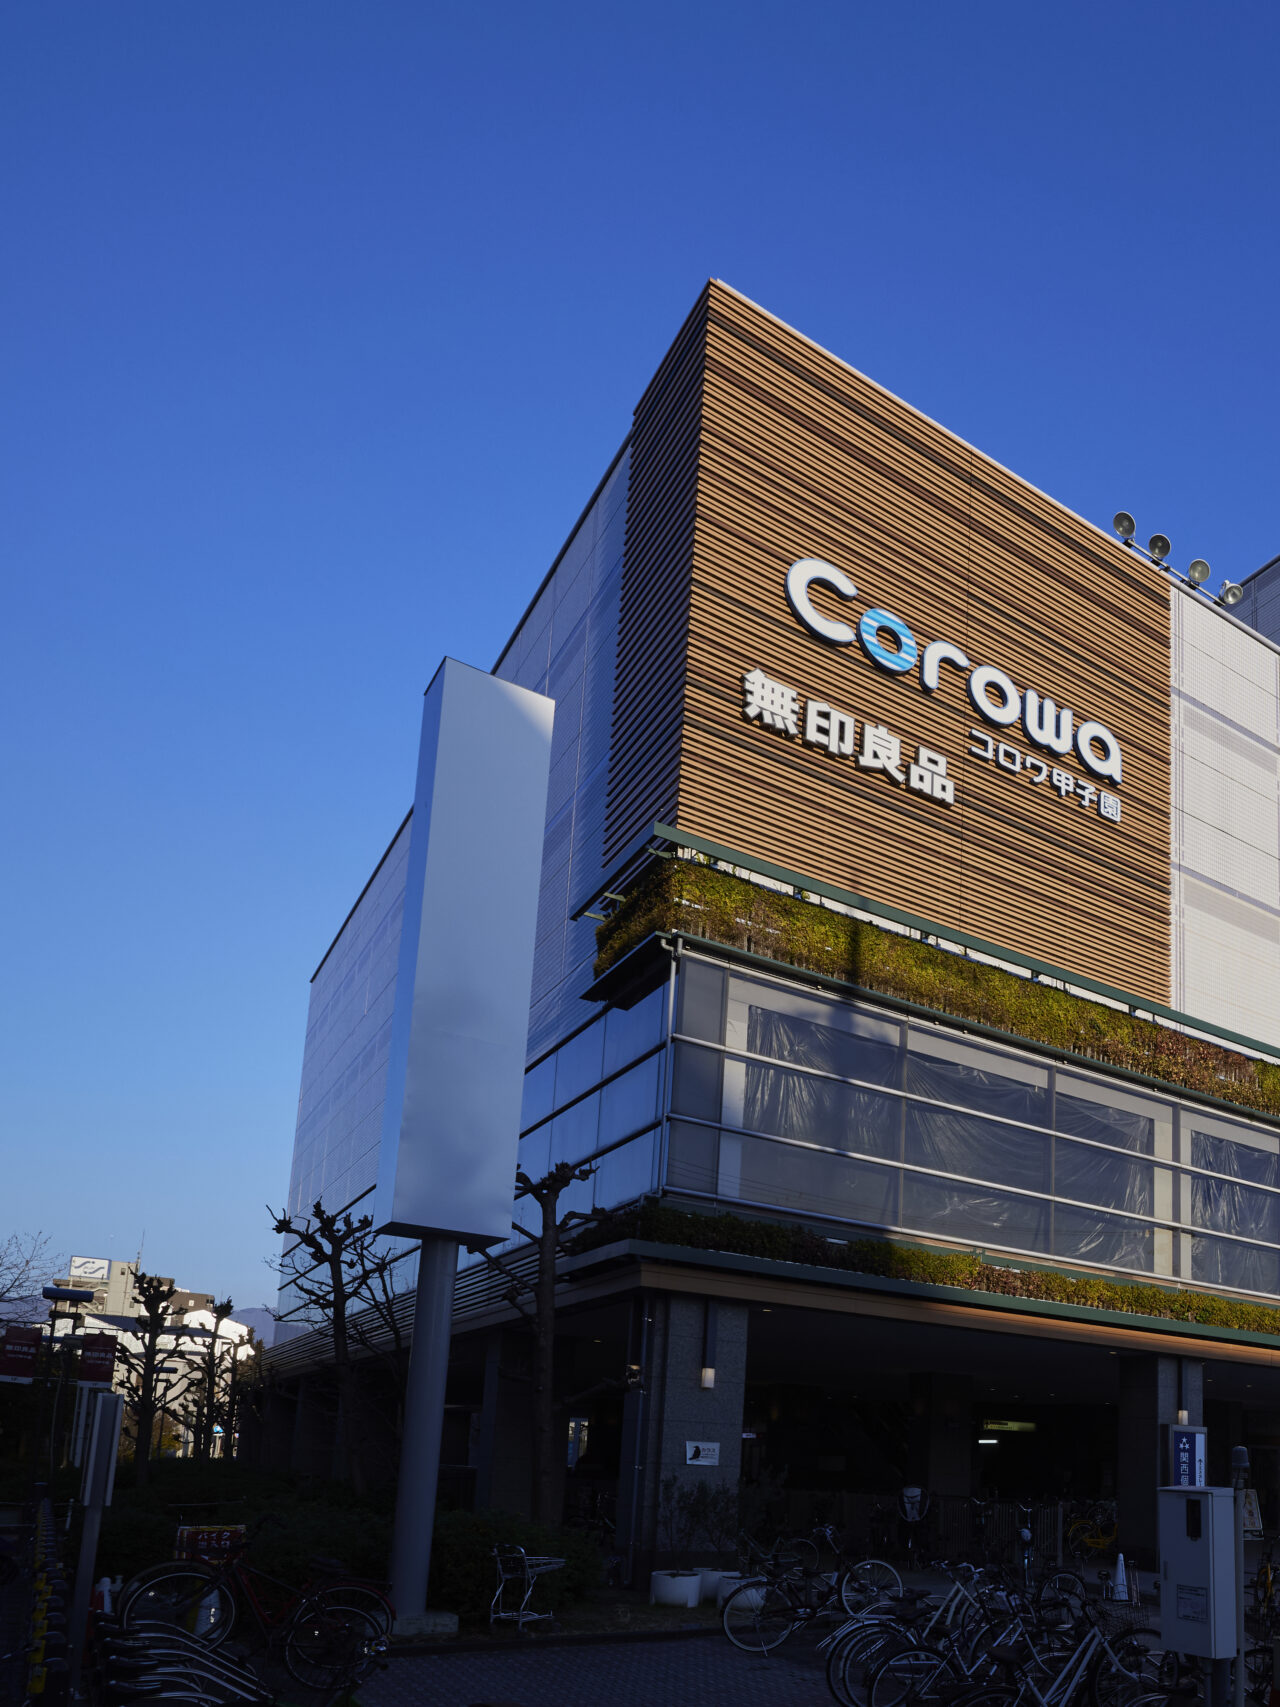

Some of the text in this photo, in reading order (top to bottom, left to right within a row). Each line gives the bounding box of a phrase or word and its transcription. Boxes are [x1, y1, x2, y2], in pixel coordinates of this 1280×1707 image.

[742, 668, 956, 808] 無印良品
[784, 558, 1122, 785] Corowa
[968, 729, 1122, 823] コロワ甲子園
